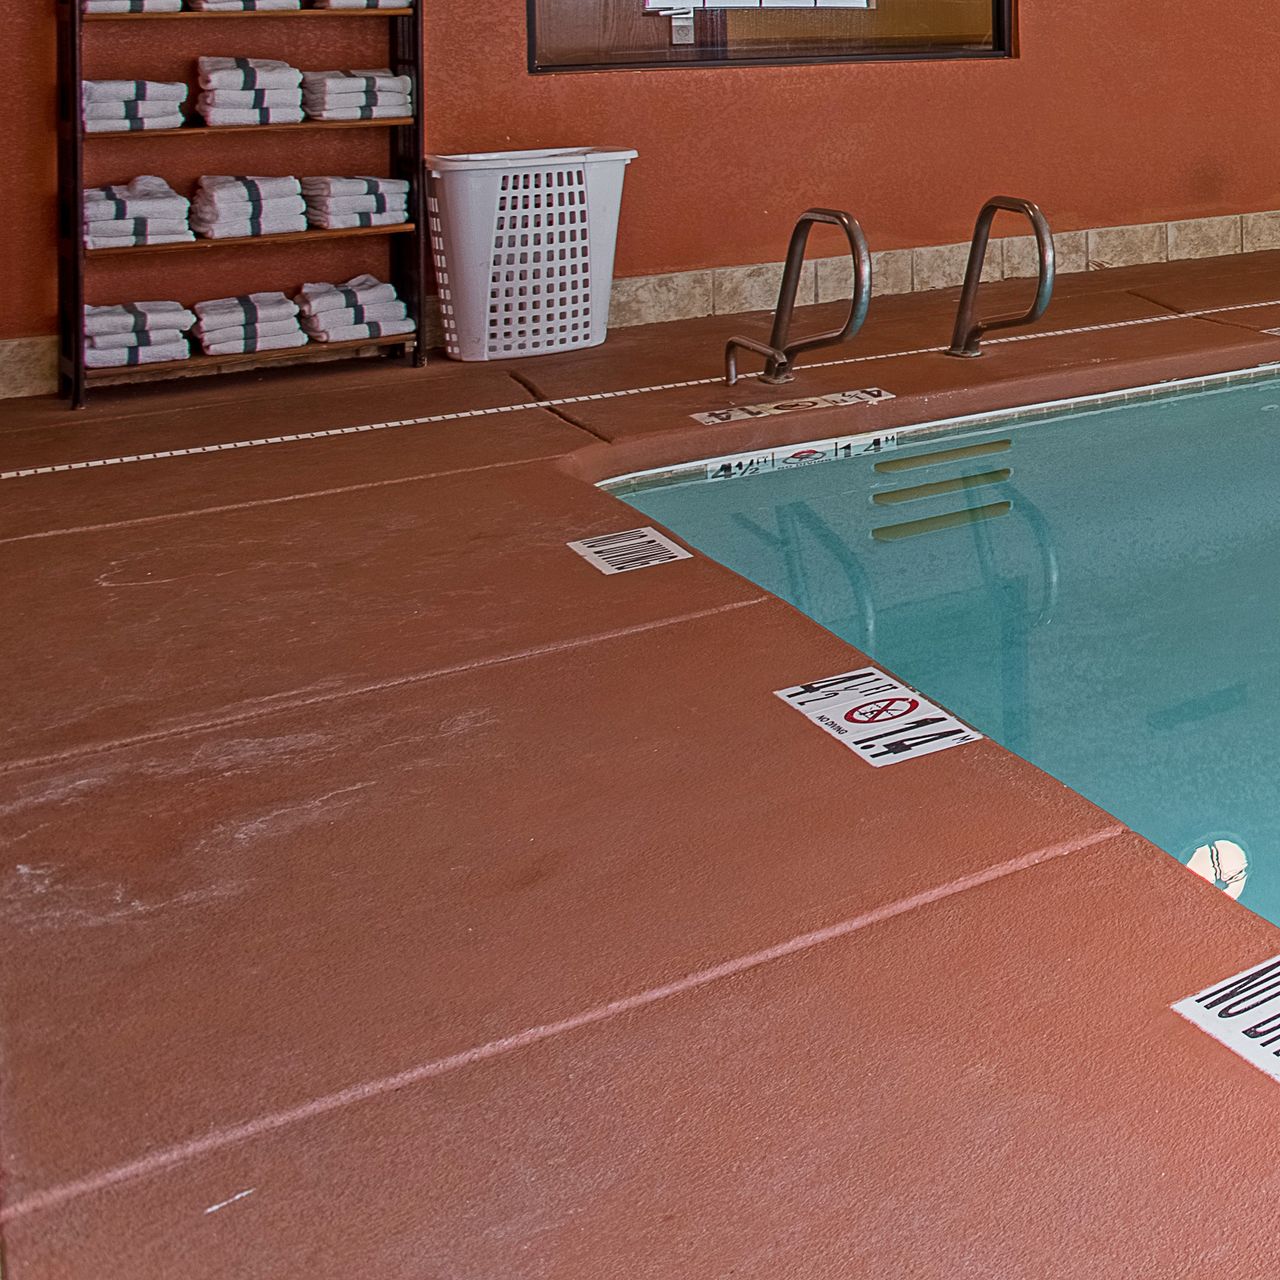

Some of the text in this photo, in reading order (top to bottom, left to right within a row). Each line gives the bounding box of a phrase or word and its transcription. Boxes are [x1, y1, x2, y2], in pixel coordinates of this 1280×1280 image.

[838, 437, 884, 459] 1.4
[580, 529, 679, 571] NO DIVING
[858, 683, 900, 697] FT
[816, 714, 849, 735] NO DIVING
[853, 716, 975, 759] 1.4 M
